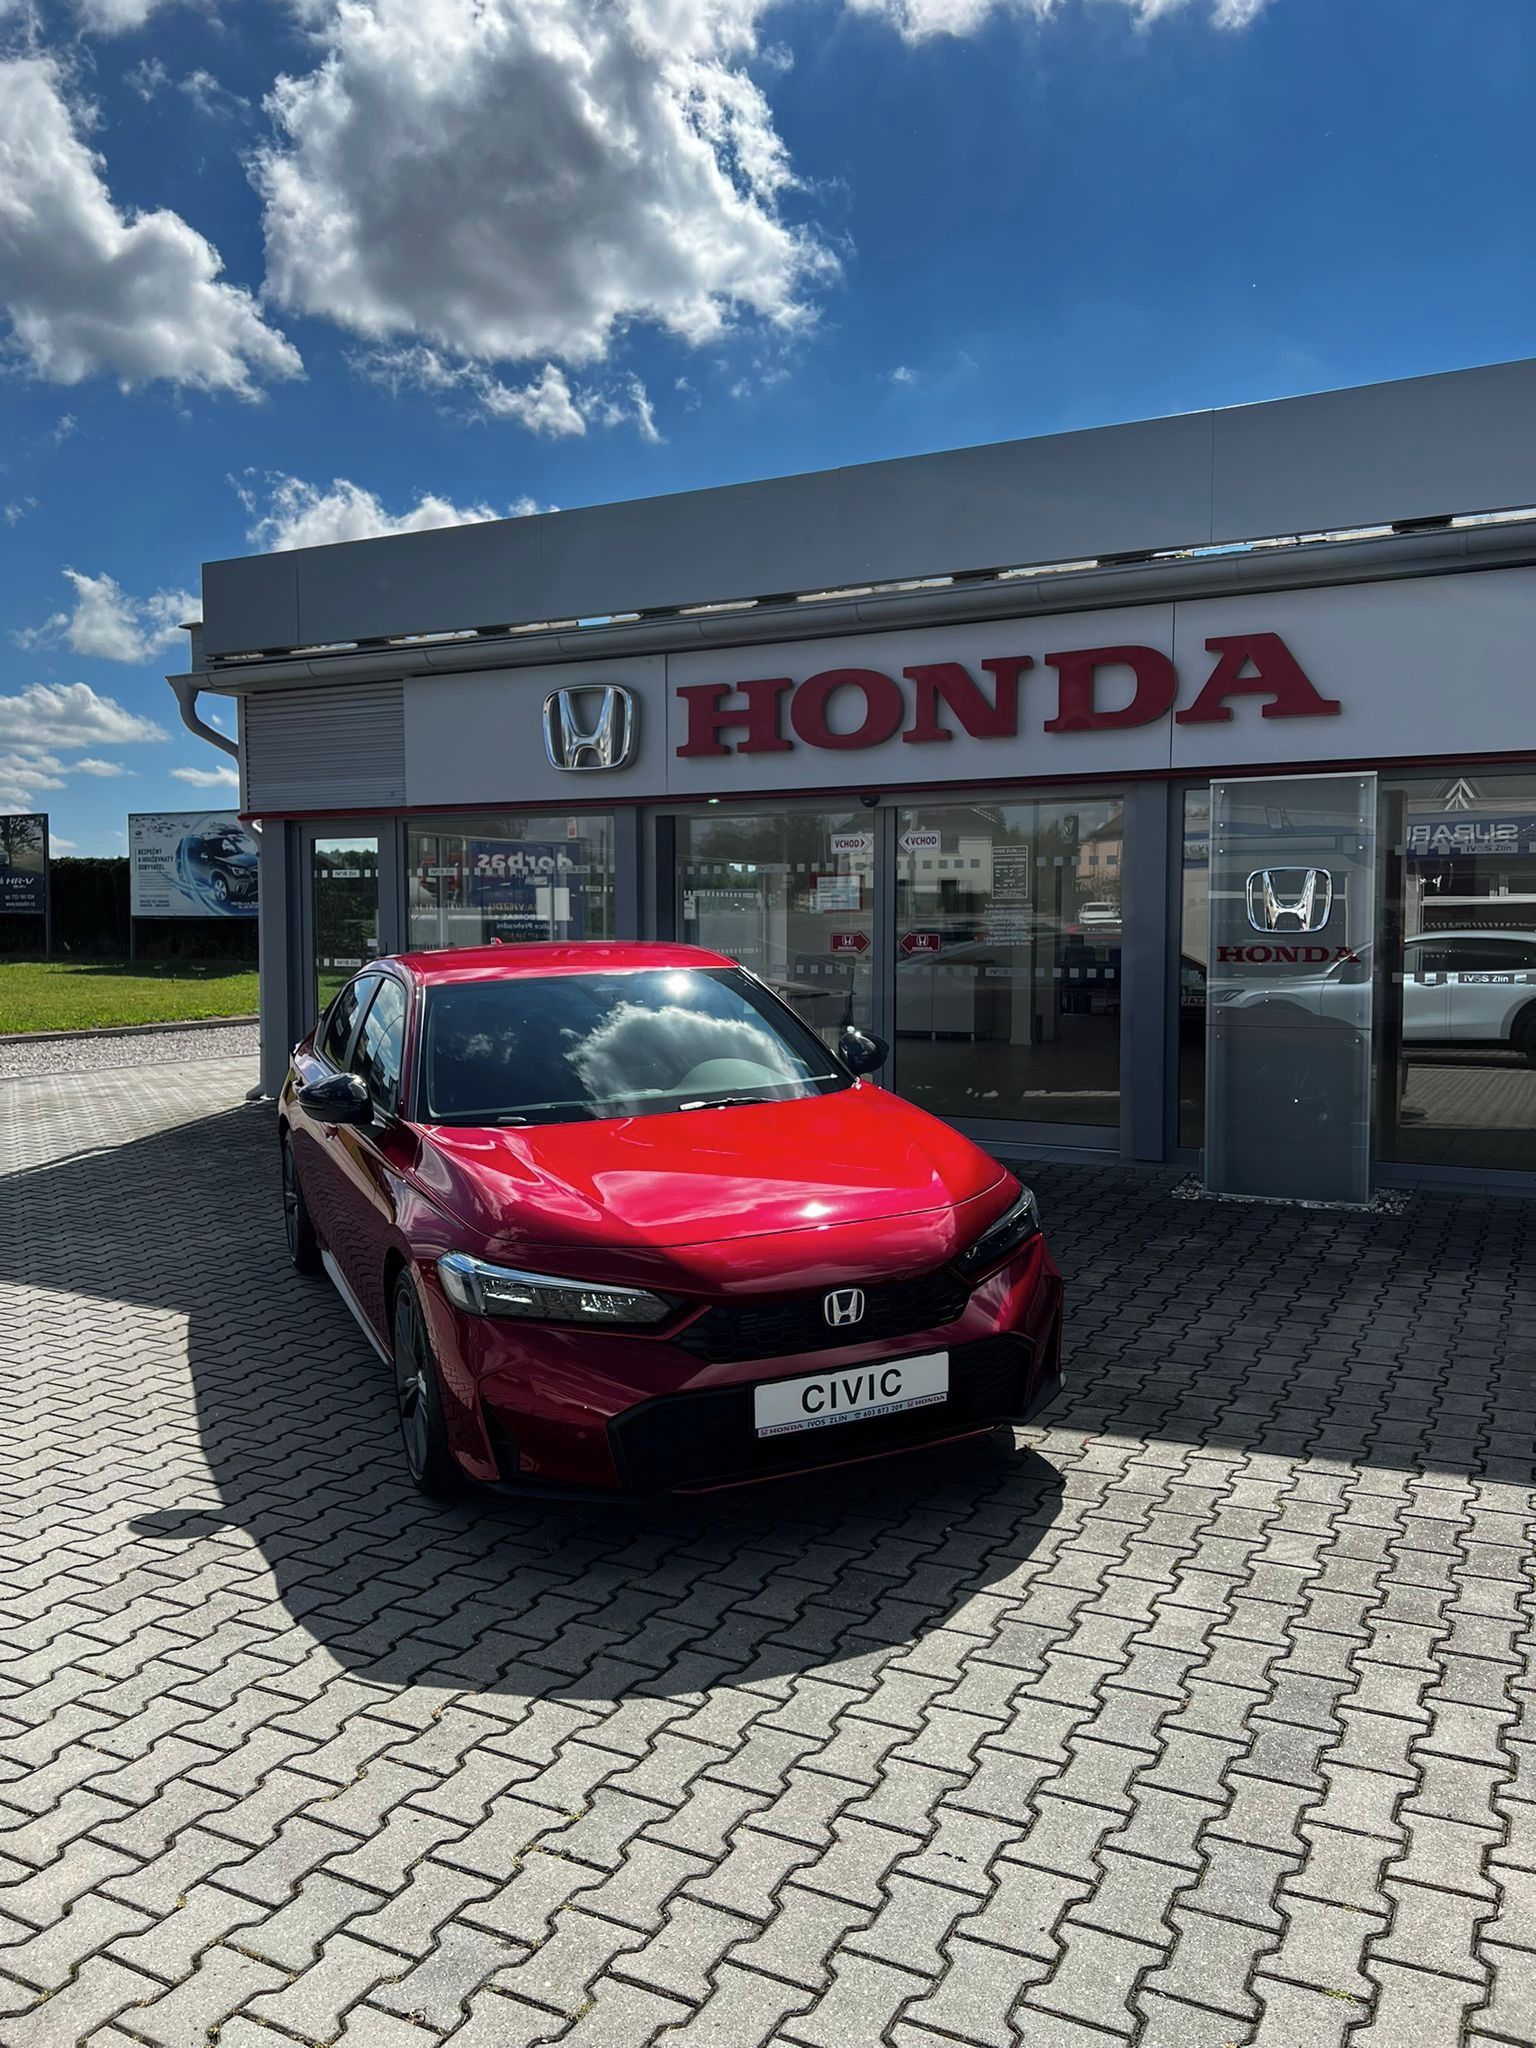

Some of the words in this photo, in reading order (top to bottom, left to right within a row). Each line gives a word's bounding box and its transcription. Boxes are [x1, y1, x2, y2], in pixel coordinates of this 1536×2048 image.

[675, 632, 1341, 757] HONDA
[834, 839, 860, 848] VCHOD
[911, 836, 936, 846] VCHOD
[6, 877, 34, 885] HR-V
[1216, 945, 1360, 963] HONDA
[801, 1368, 902, 1414] CIVIC
[769, 1423, 804, 1435] HONDA
[807, 1418, 826, 1428] IVOS
[862, 1409, 876, 1417] 603
[877, 1406, 890, 1415] 873
[891, 1403, 903, 1412] 209
[915, 1396, 946, 1406] HONDA
